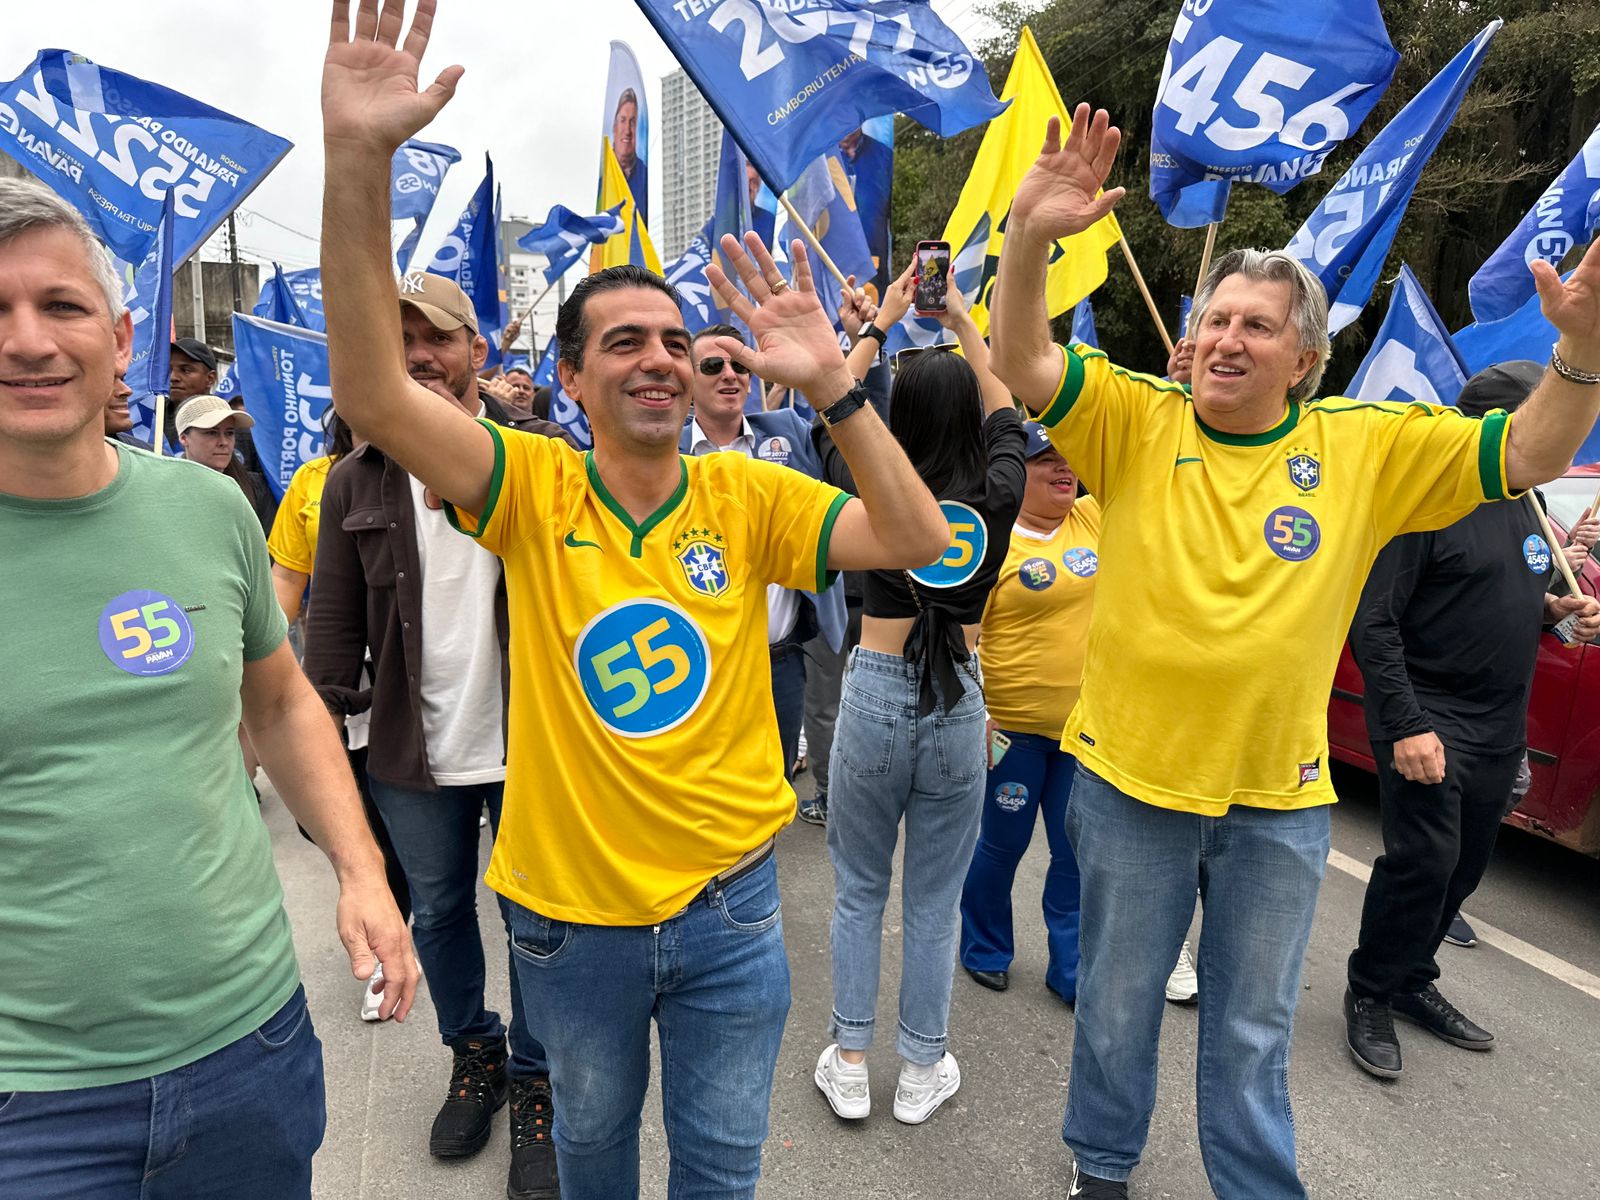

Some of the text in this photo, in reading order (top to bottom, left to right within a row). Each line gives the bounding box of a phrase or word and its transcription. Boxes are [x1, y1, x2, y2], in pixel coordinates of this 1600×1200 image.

[767, 75, 825, 126] CAMBORIÚ
[822, 58, 850, 84] TEM
[1206, 164, 1253, 174] PREFEITO
[1272, 515, 1312, 547] 55
[697, 562, 713, 572] CBF
[1073, 556, 1097, 573] 45456
[1528, 553, 1549, 565] 45456
[1030, 569, 1050, 585] 55
[110, 601, 181, 659] 55
[145, 649, 173, 664] PAVAN
[591, 617, 691, 718] 55
[996, 794, 1026, 806] 45456
